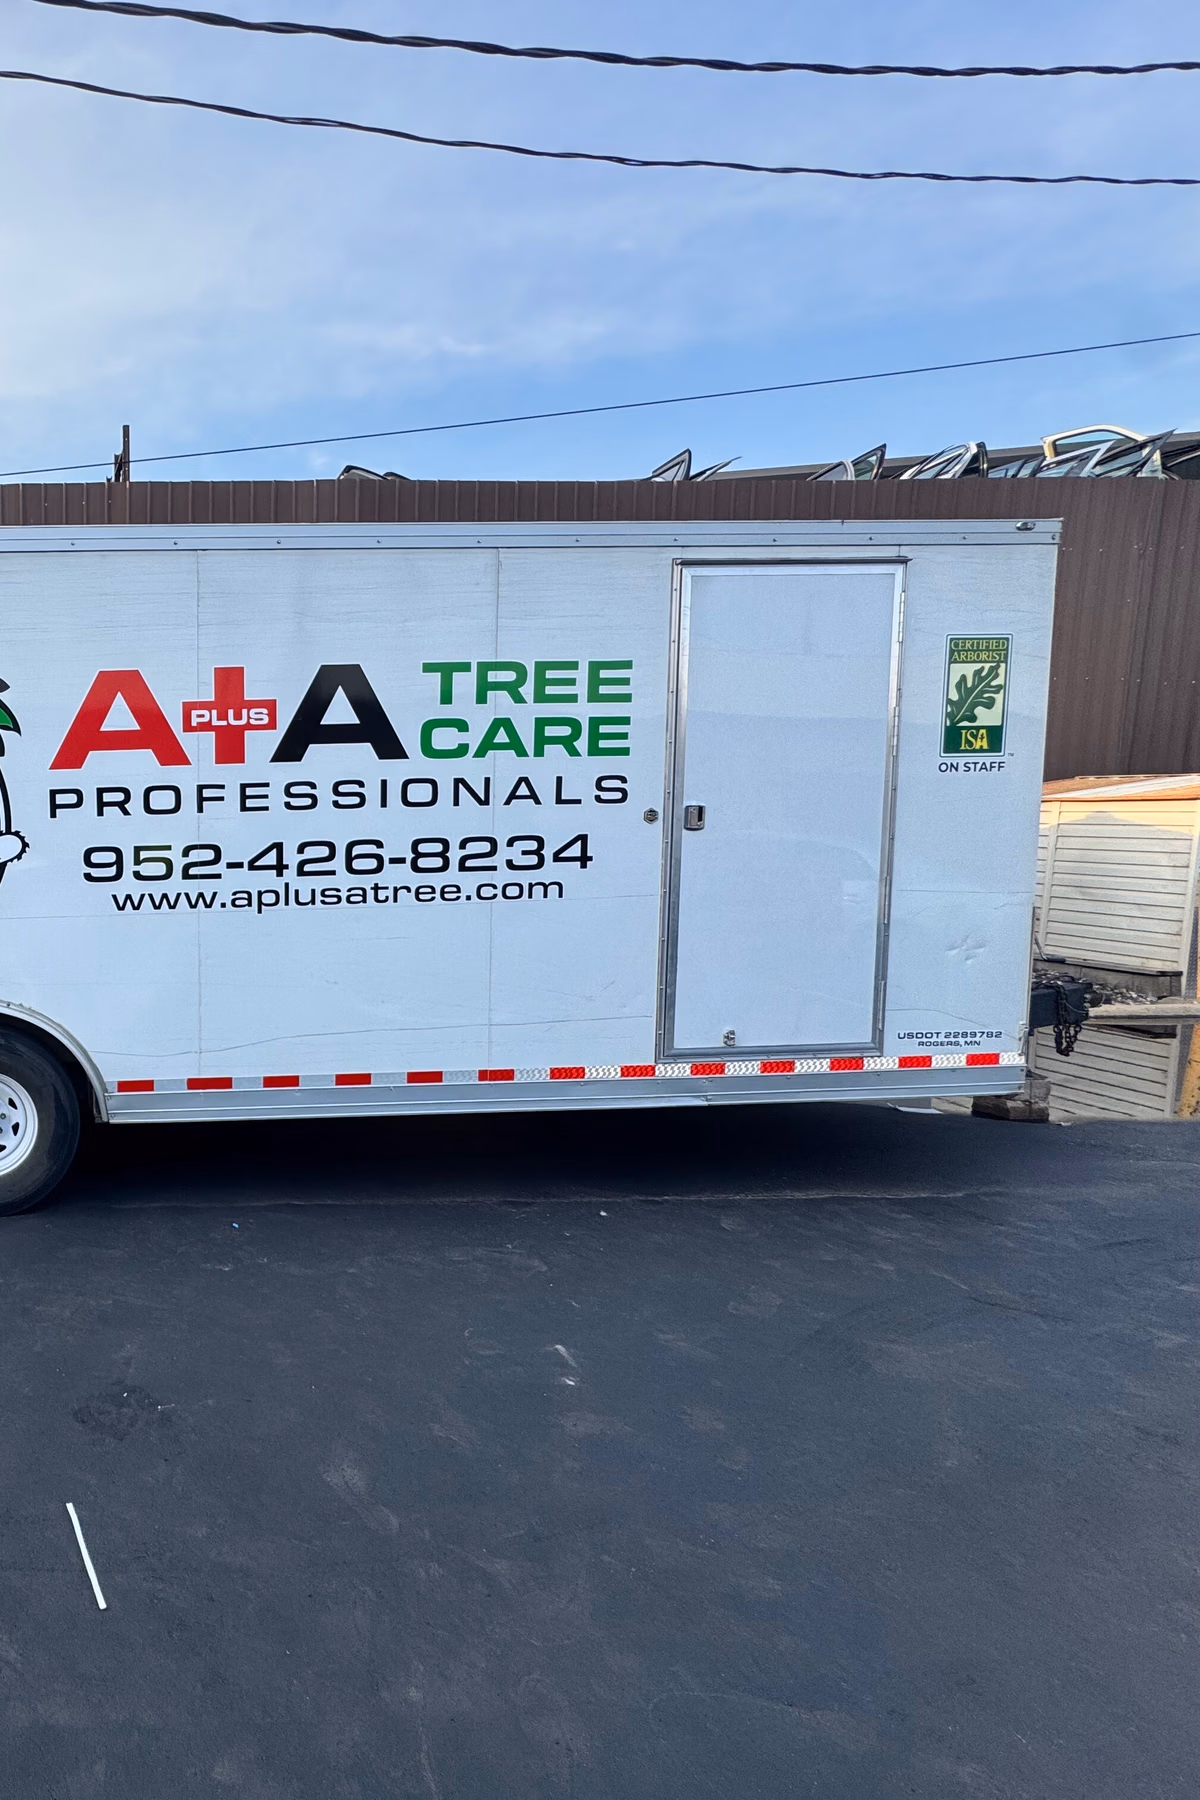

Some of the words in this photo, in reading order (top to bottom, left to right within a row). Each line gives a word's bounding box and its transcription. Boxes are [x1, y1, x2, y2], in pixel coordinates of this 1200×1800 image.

[951, 640, 1007, 650] CERTIFIED
[951, 651, 1006, 662] ARBORIST
[421, 659, 633, 706] TREE
[191, 708, 270, 727] PLUS
[419, 715, 631, 760] CARE
[959, 729, 989, 749] ISA
[938, 762, 959, 773] ON
[963, 761, 1006, 773] STAFF
[48, 774, 630, 819] PROFESSIONALS
[83, 833, 594, 884] 952-426-8234
[111, 879, 565, 915] www.aplusatree.com
[897, 1032, 941, 1040] USDOT
[943, 1031, 1003, 1039] 2289782
